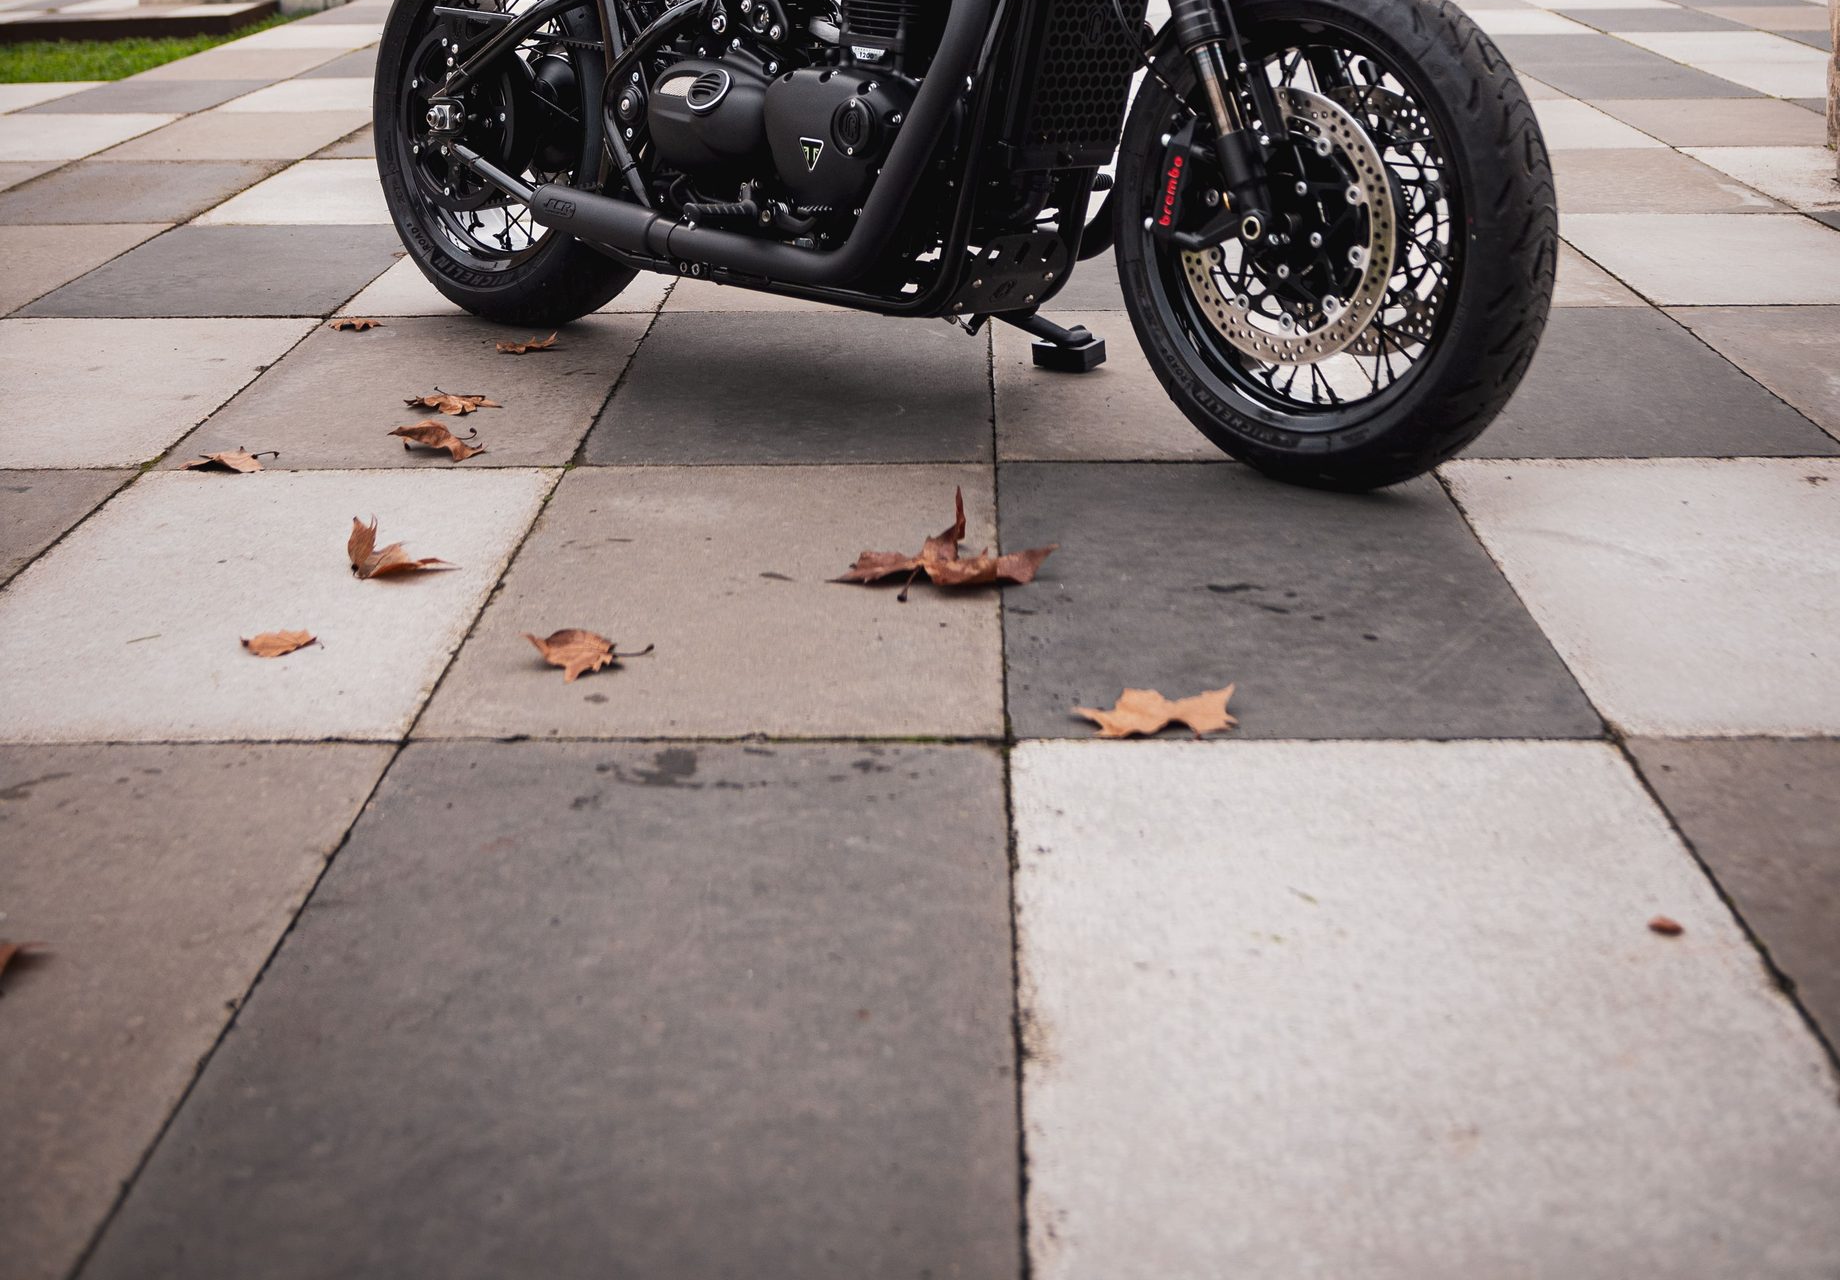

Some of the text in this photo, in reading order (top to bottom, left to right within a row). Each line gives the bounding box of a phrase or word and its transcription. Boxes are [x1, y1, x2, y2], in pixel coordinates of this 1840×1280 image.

[1158, 155, 1184, 226] brembo
[433, 254, 514, 288] MICHELIN
[1195, 391, 1277, 442] MICHELIN
